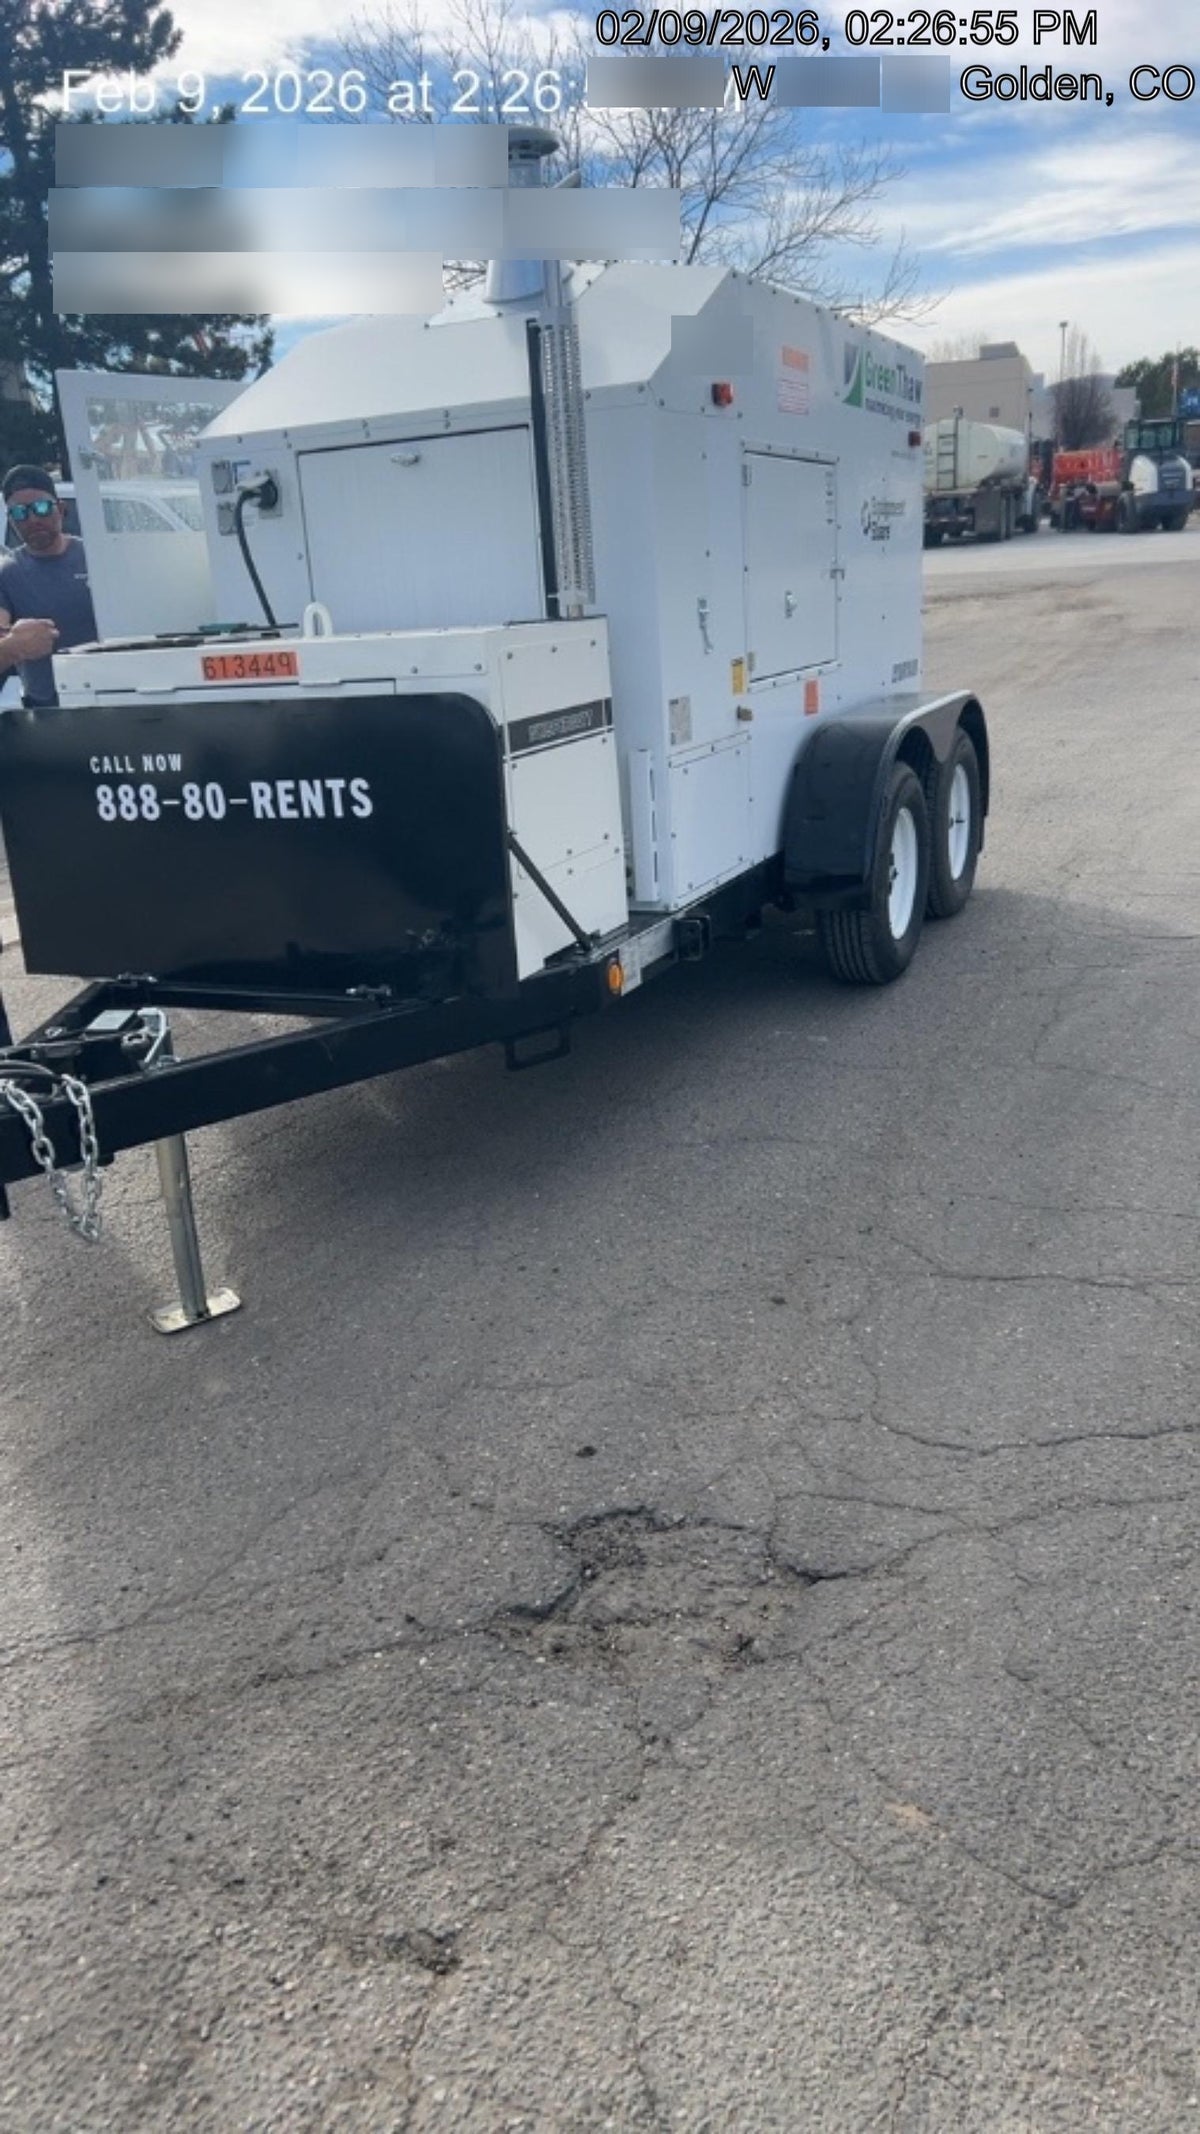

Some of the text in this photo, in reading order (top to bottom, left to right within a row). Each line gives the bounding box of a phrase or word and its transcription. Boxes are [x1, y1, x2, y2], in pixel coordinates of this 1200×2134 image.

[203, 651, 293, 681] 613449
[89, 753, 182, 774] CALL NOW
[96, 777, 374, 822] 888-80-RENTS
